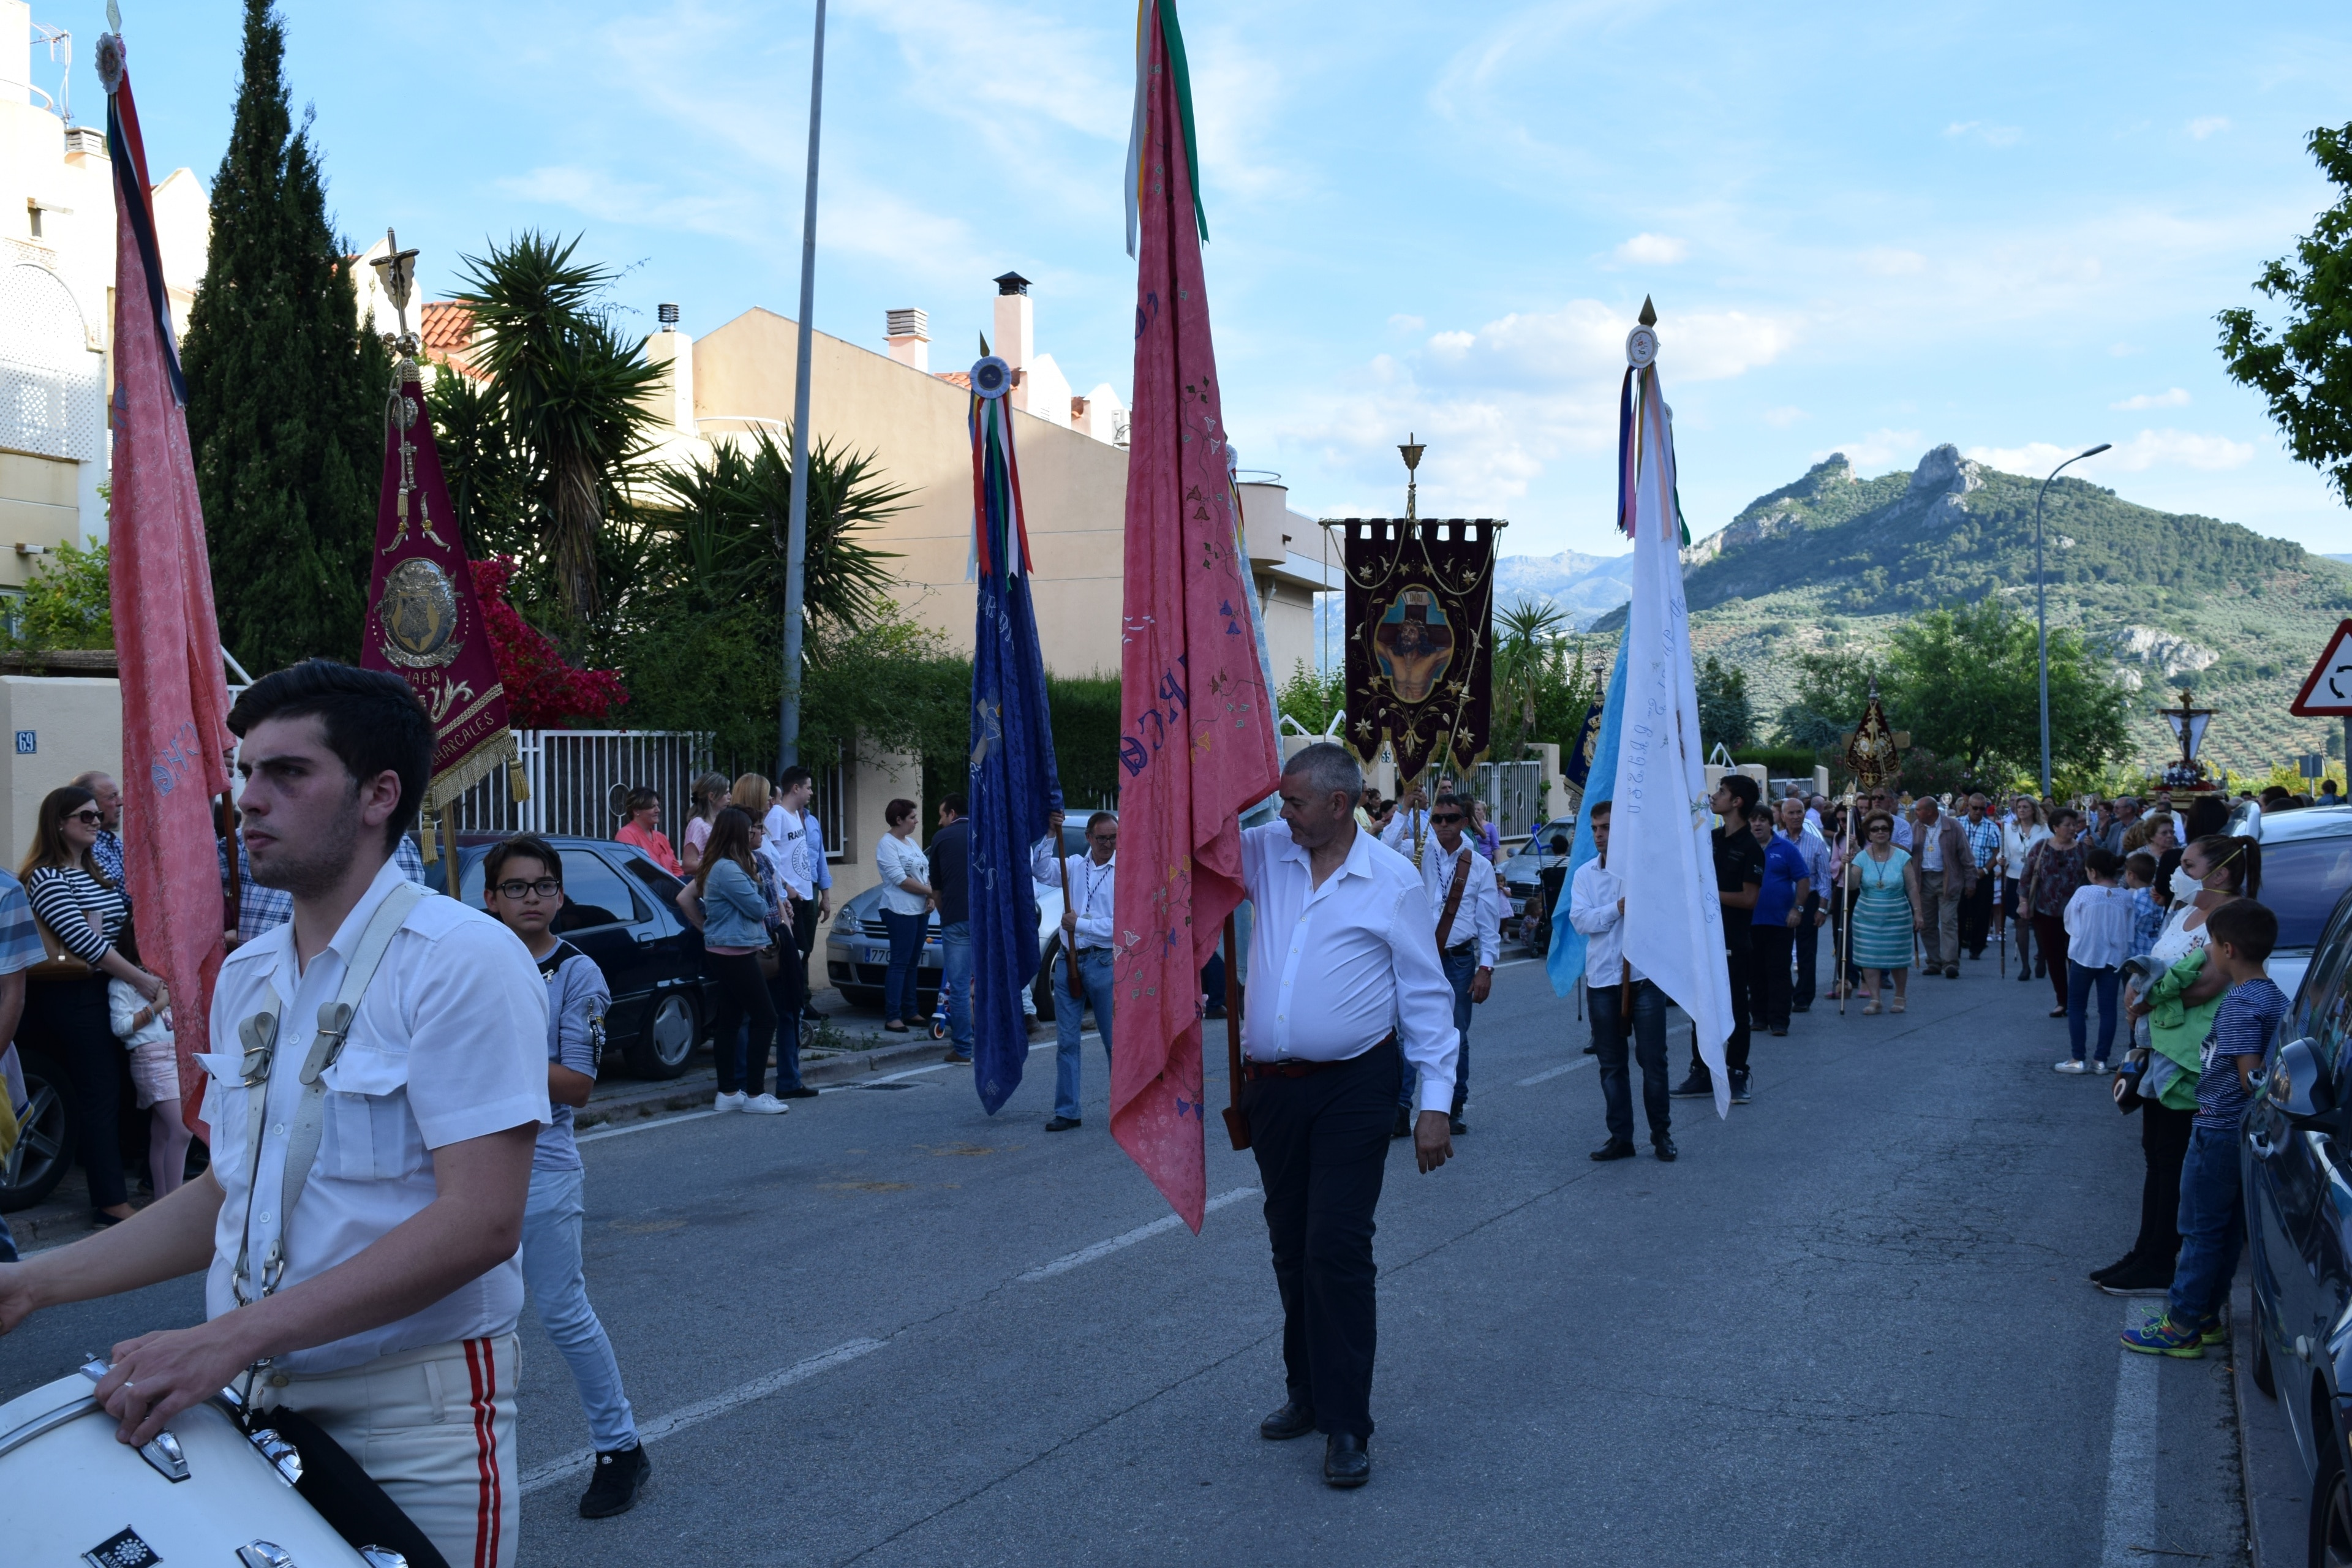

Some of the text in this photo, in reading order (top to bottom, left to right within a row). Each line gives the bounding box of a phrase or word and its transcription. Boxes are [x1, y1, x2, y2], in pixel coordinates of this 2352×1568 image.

[1409, 593, 1423, 603] INRI
[405, 669, 440, 685] JAEN
[19, 733, 33, 751] 69
[1382, 751, 1391, 763] 55
